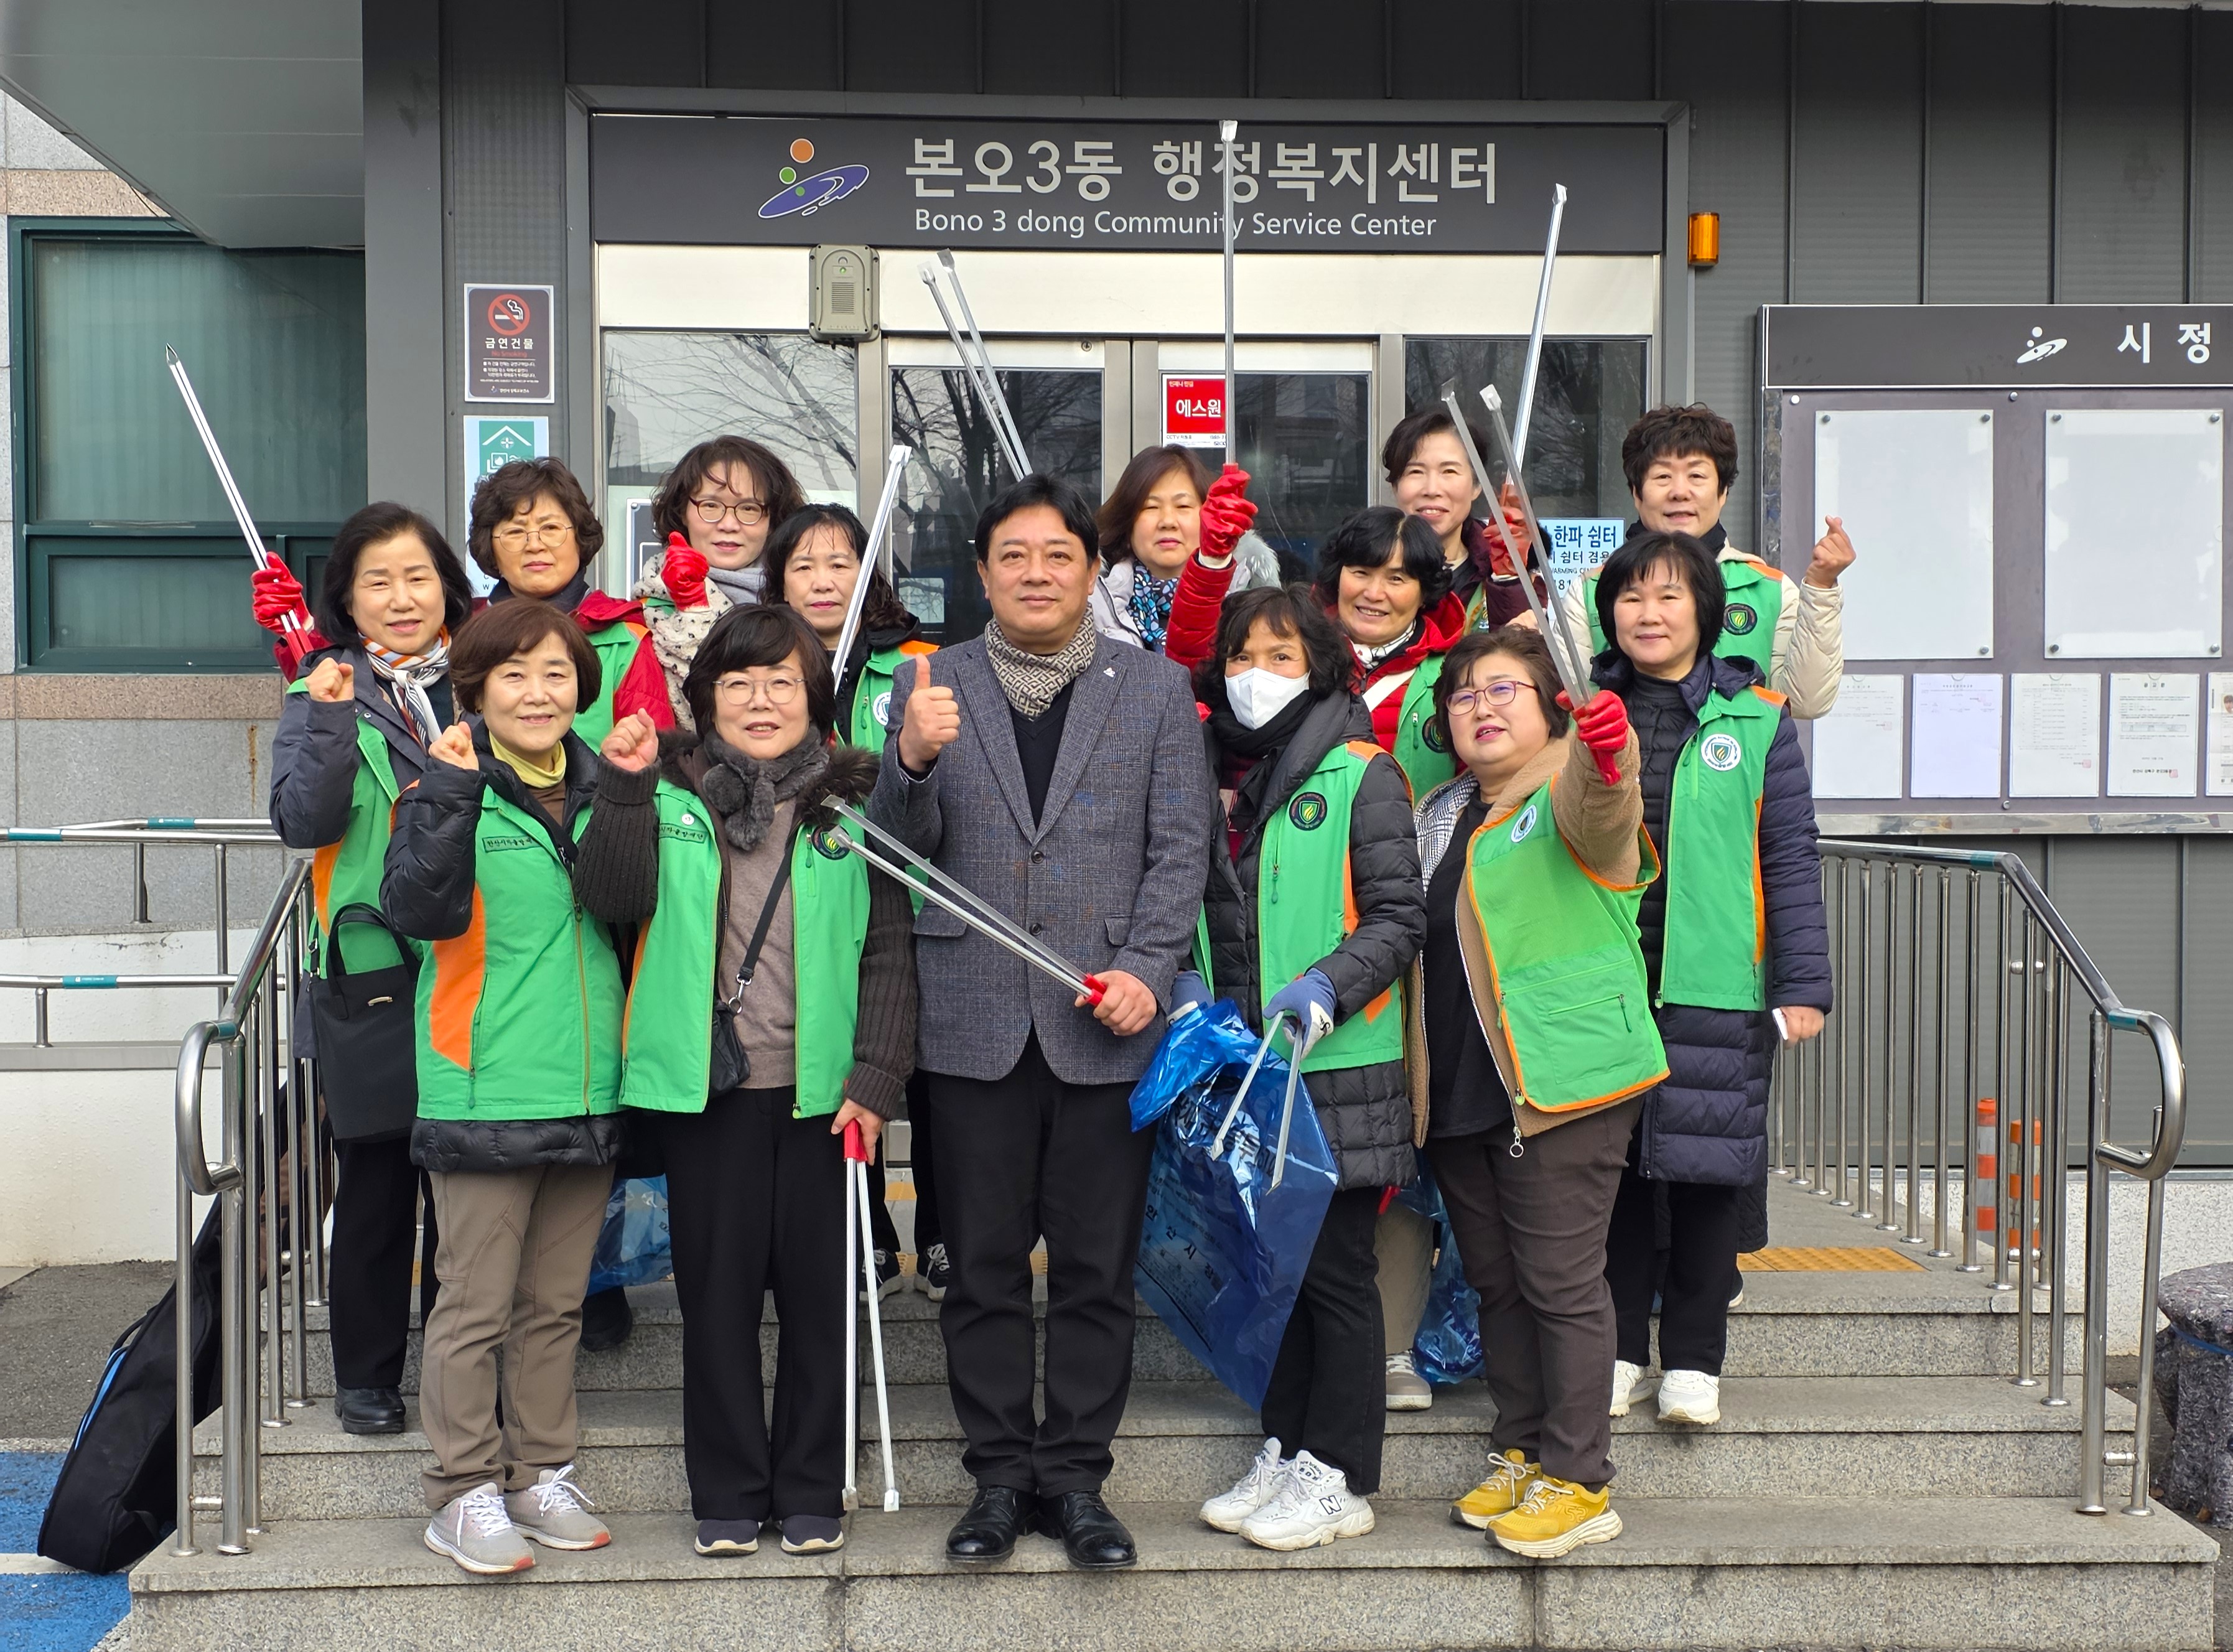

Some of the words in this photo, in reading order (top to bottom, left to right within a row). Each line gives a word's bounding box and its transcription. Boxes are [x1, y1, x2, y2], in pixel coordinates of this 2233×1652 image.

[905, 138, 1122, 202] 본오3동
[1152, 140, 1495, 204] 행정복지센터
[915, 208, 983, 231] Bono
[992, 209, 1007, 231] 3
[1017, 208, 1084, 238] dong
[1252, 212, 1342, 235] Service
[1350, 212, 1437, 236] Center
[485, 337, 534, 350] 금연건물
[1175, 398, 1222, 418] 에스원
[1553, 525, 1583, 548] 한파
[1587, 525, 1616, 549] 쉼터
[1560, 550, 1583, 564] 쉼터
